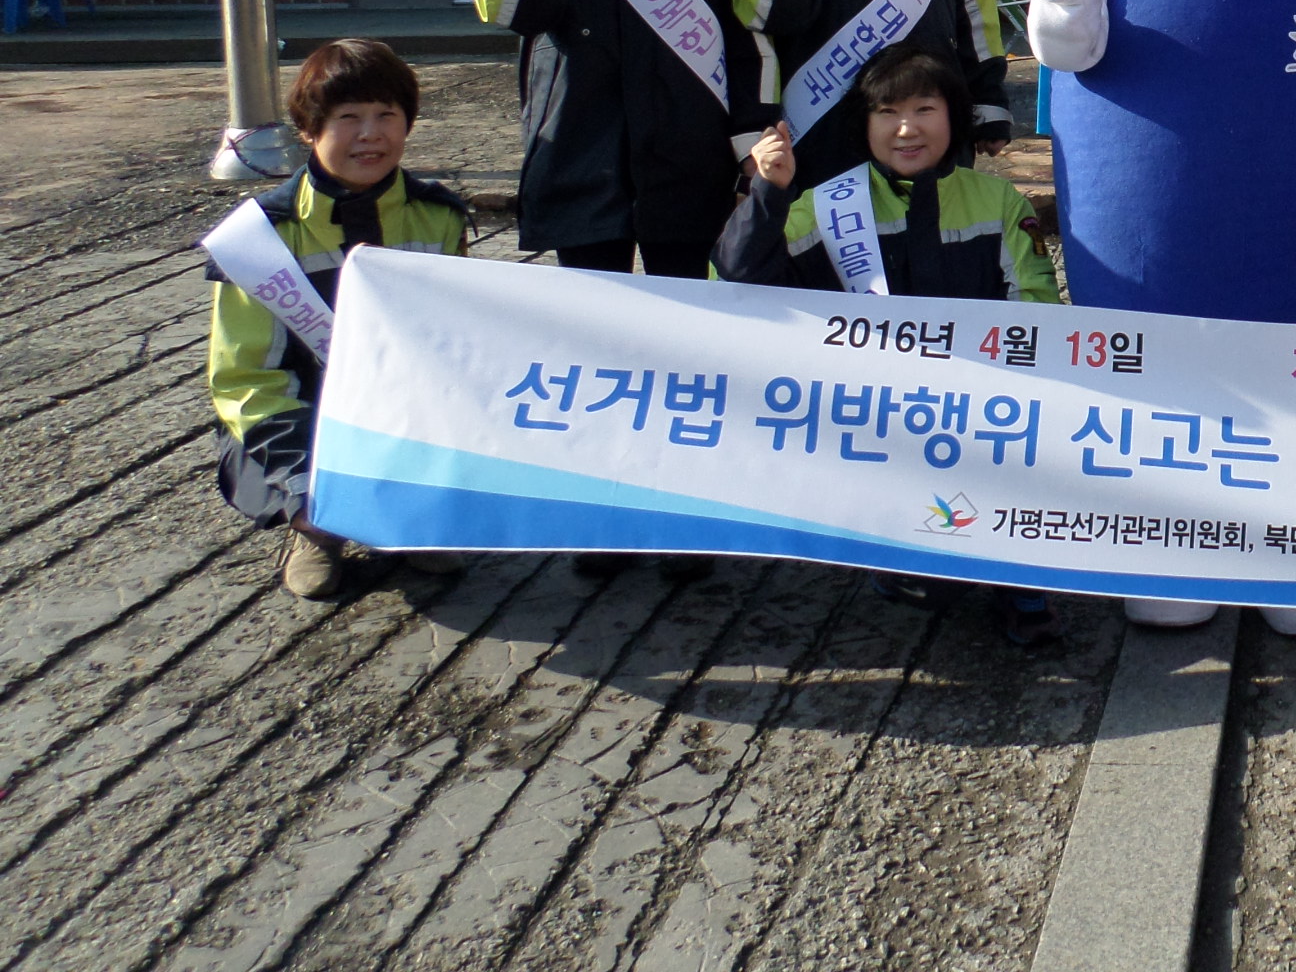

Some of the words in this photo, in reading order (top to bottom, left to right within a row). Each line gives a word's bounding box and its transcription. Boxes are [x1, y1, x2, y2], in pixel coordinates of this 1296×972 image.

[823, 177, 879, 295] 름다운
[824, 315, 955, 360] 2016년
[980, 325, 1039, 367] 4월
[1066, 331, 1144, 374] 13일
[505, 362, 728, 448] 선거법
[755, 376, 1041, 470] 위반행위
[1071, 406, 1280, 490] 신고는
[992, 507, 1254, 554] 가평군선거관리위원회,
